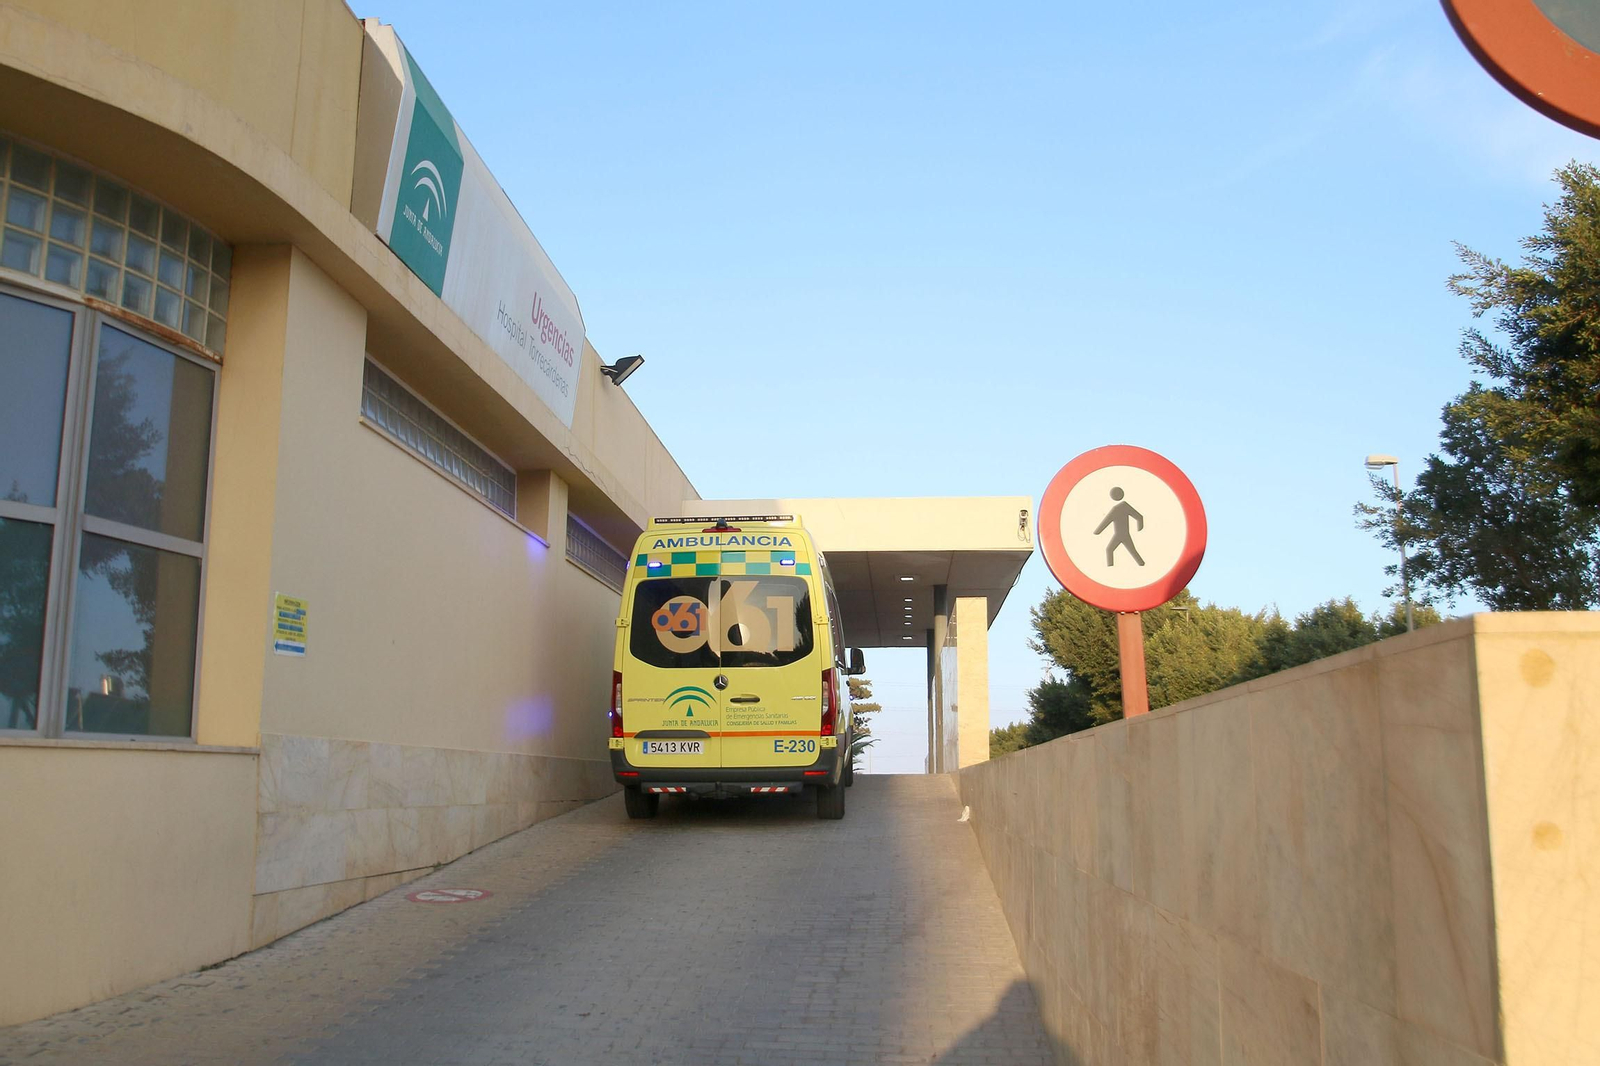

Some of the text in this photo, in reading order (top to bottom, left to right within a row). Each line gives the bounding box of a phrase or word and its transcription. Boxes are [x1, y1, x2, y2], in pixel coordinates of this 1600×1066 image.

[497, 299, 528, 349] Hospital
[531, 291, 574, 367] Urgencias
[653, 535, 792, 549] AMBULANCIA
[651, 602, 707, 632] 061
[651, 742, 700, 753] 5413 KVR
[774, 740, 816, 753] E-230
